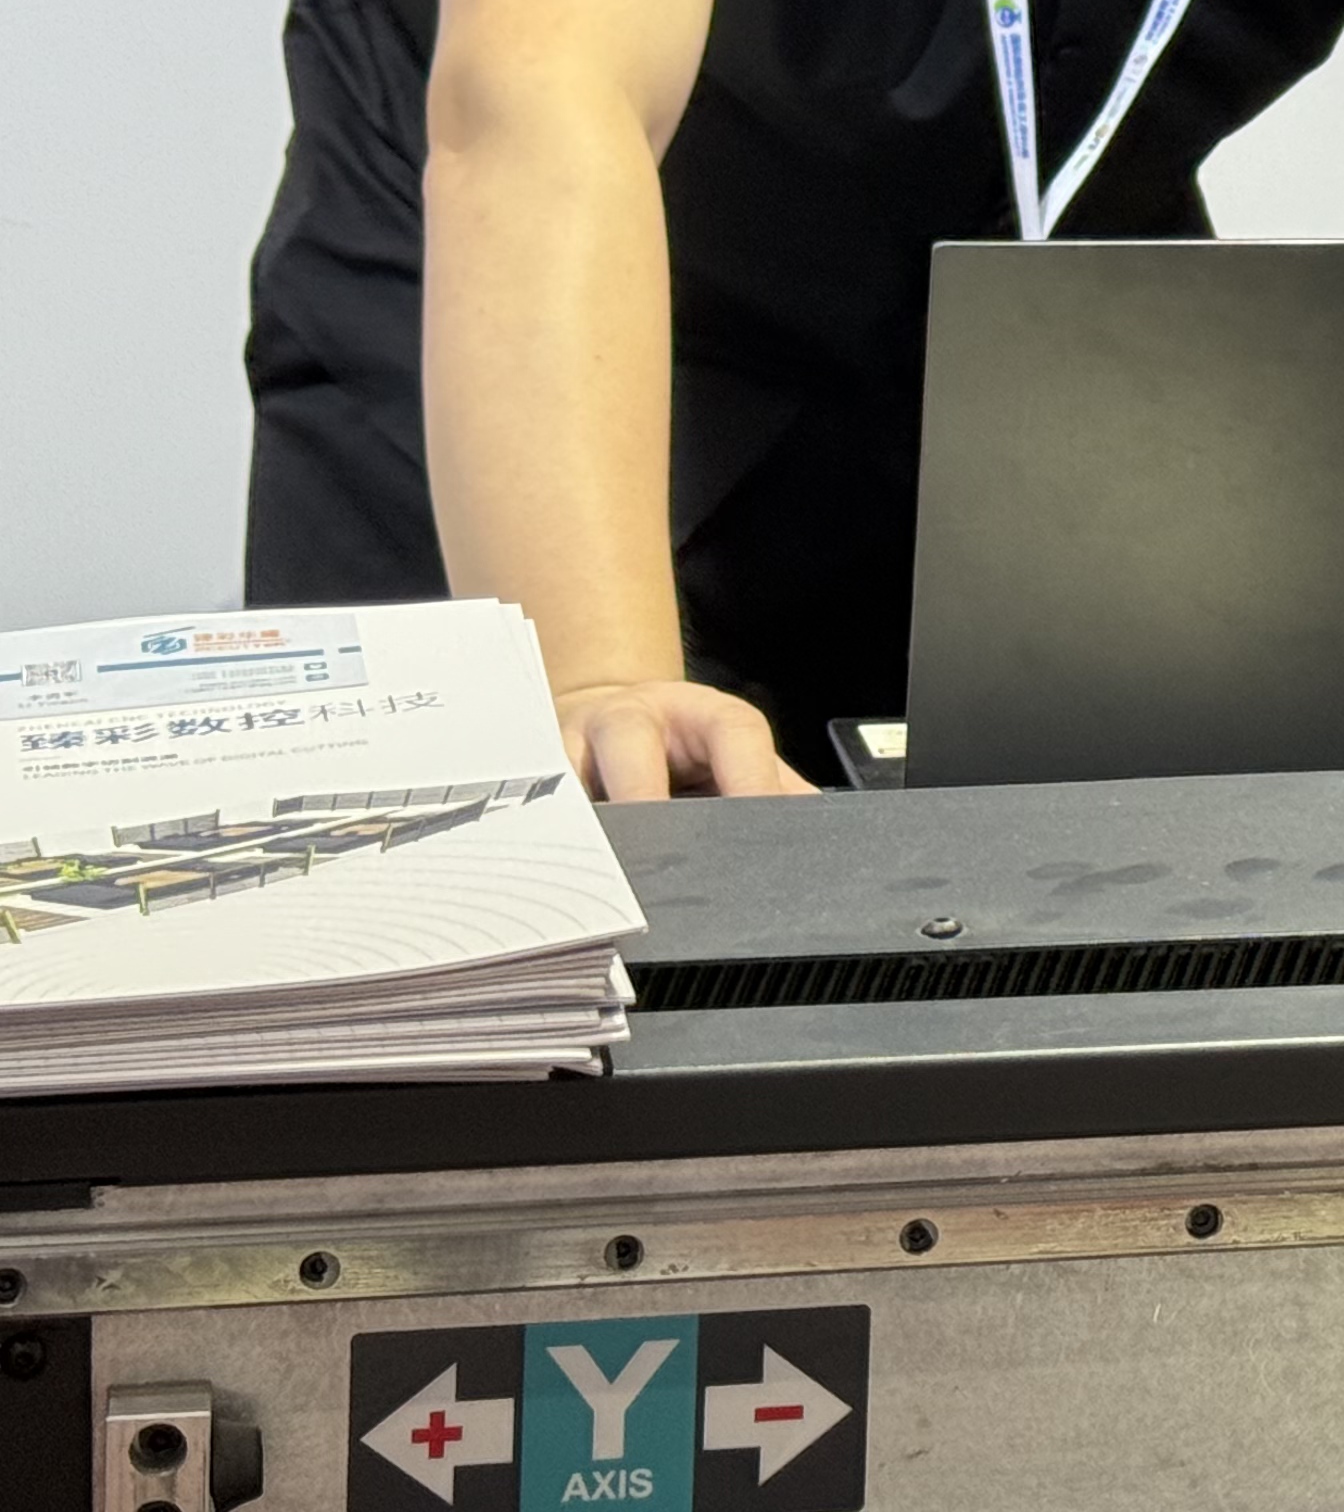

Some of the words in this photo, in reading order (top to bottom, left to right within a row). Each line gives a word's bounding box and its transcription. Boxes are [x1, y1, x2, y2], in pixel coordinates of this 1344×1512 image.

[20, 691, 444, 752] 臻彩数控科技
[546, 1338, 680, 1462] Y
[560, 1468, 654, 1504] AXIS
